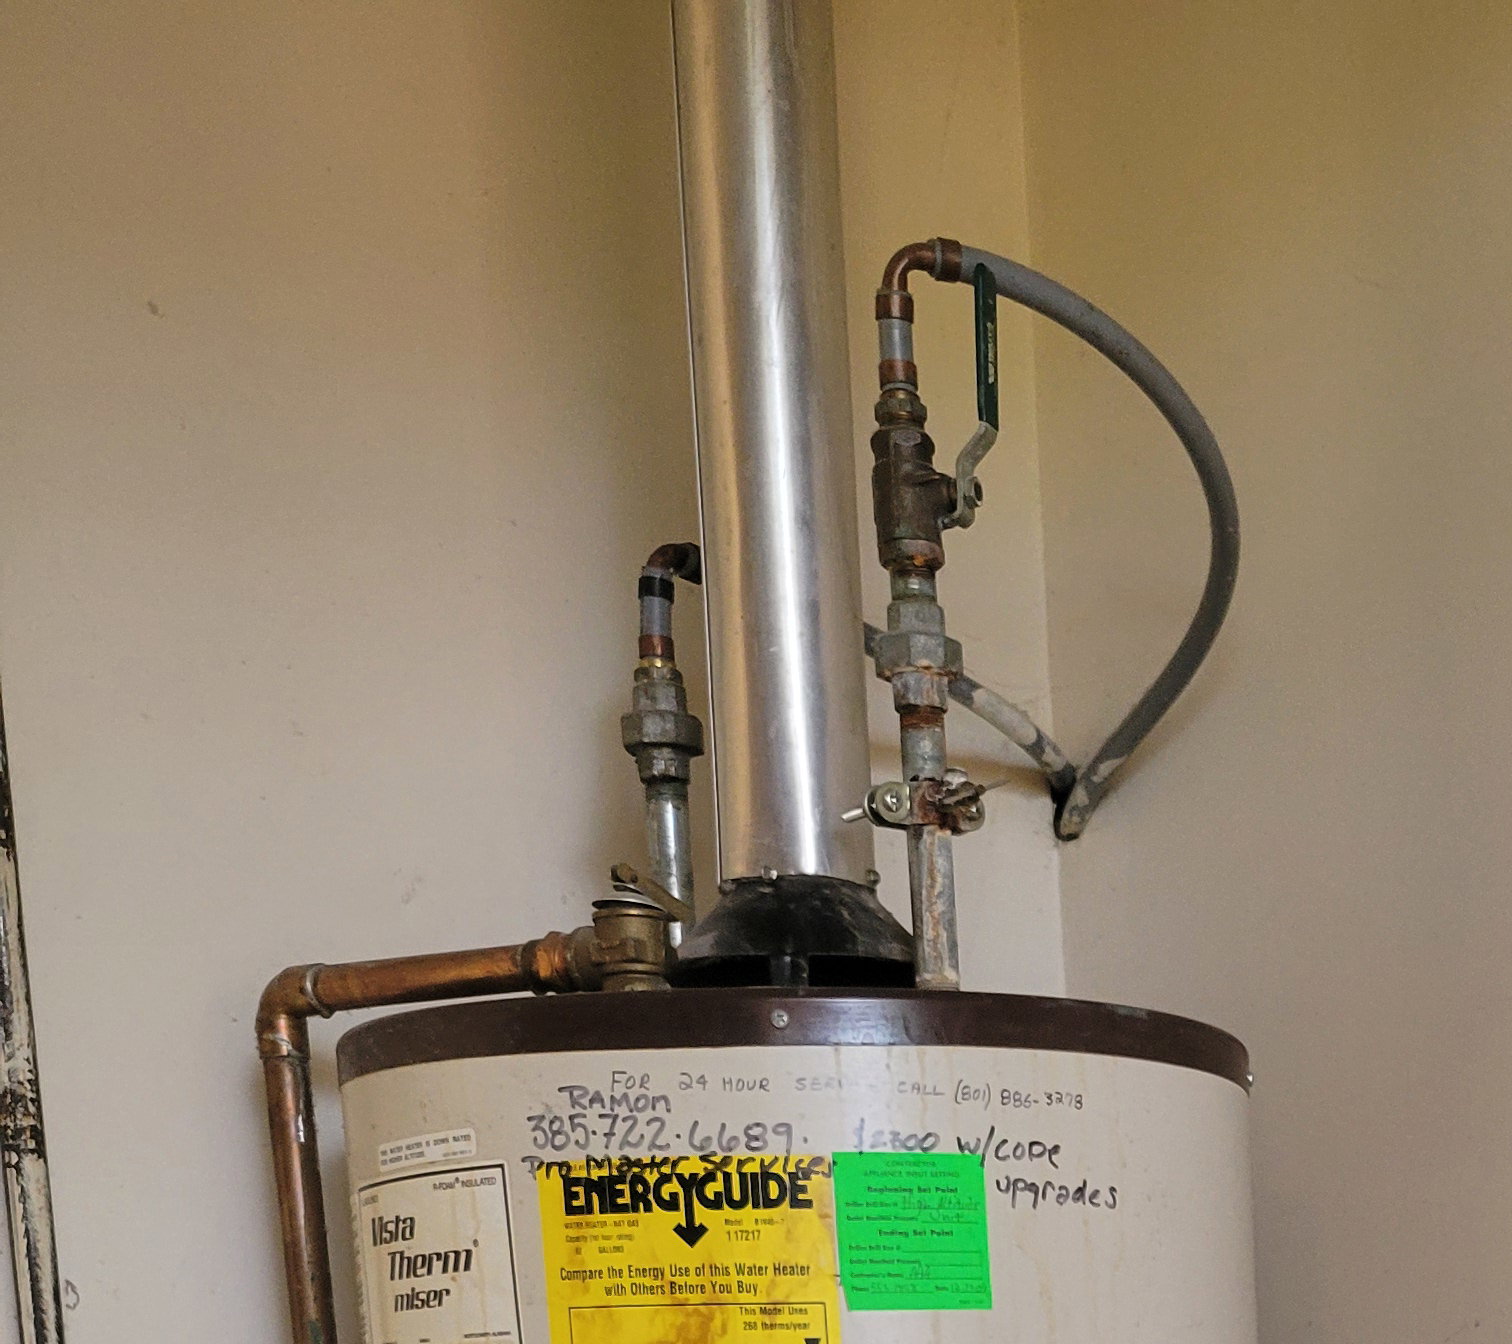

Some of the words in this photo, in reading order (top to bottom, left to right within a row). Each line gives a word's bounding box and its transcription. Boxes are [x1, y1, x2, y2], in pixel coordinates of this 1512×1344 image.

[611, 1070, 650, 1092] FOR
[679, 1072, 708, 1091] 24
[722, 1076, 770, 1092] HOUR
[897, 1080, 945, 1097] CALL
[954, 1079, 992, 1111] (801)
[563, 1172, 814, 1217] ENERGYGUIDE
[560, 1267, 604, 1283] Compare
[607, 1266, 624, 1279] the
[627, 1265, 665, 1286] Energy
[669, 1265, 691, 1278] Use
[695, 1265, 706, 1277] of
[709, 1264, 731, 1278] this
[735, 1263, 769, 1278] Water
[773, 1263, 811, 1278] Heater
[394, 1286, 451, 1313] miser
[604, 1284, 627, 1297] with
[630, 1283, 666, 1297] Others
[669, 1282, 708, 1296] Before
[711, 1282, 733, 1295] You
[739, 1306, 757, 1316] This
[759, 1306, 785, 1316] Model
[788, 1306, 808, 1316] Uses
